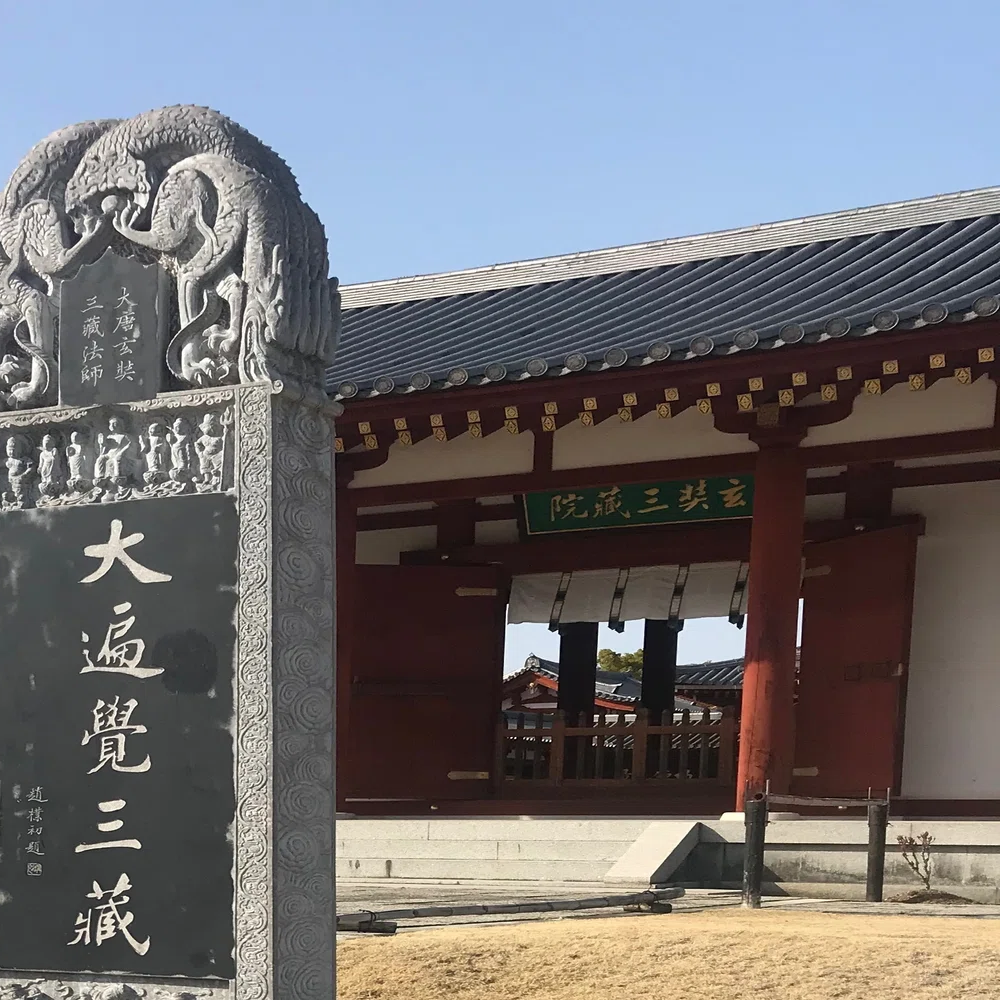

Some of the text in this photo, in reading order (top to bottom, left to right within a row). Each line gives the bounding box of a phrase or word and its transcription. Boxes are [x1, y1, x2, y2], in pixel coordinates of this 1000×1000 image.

[80, 295, 105, 387] 三藏法師
[112, 286, 138, 382] 大唐玄奘
[66, 518, 173, 956] 大遍覺三藏
